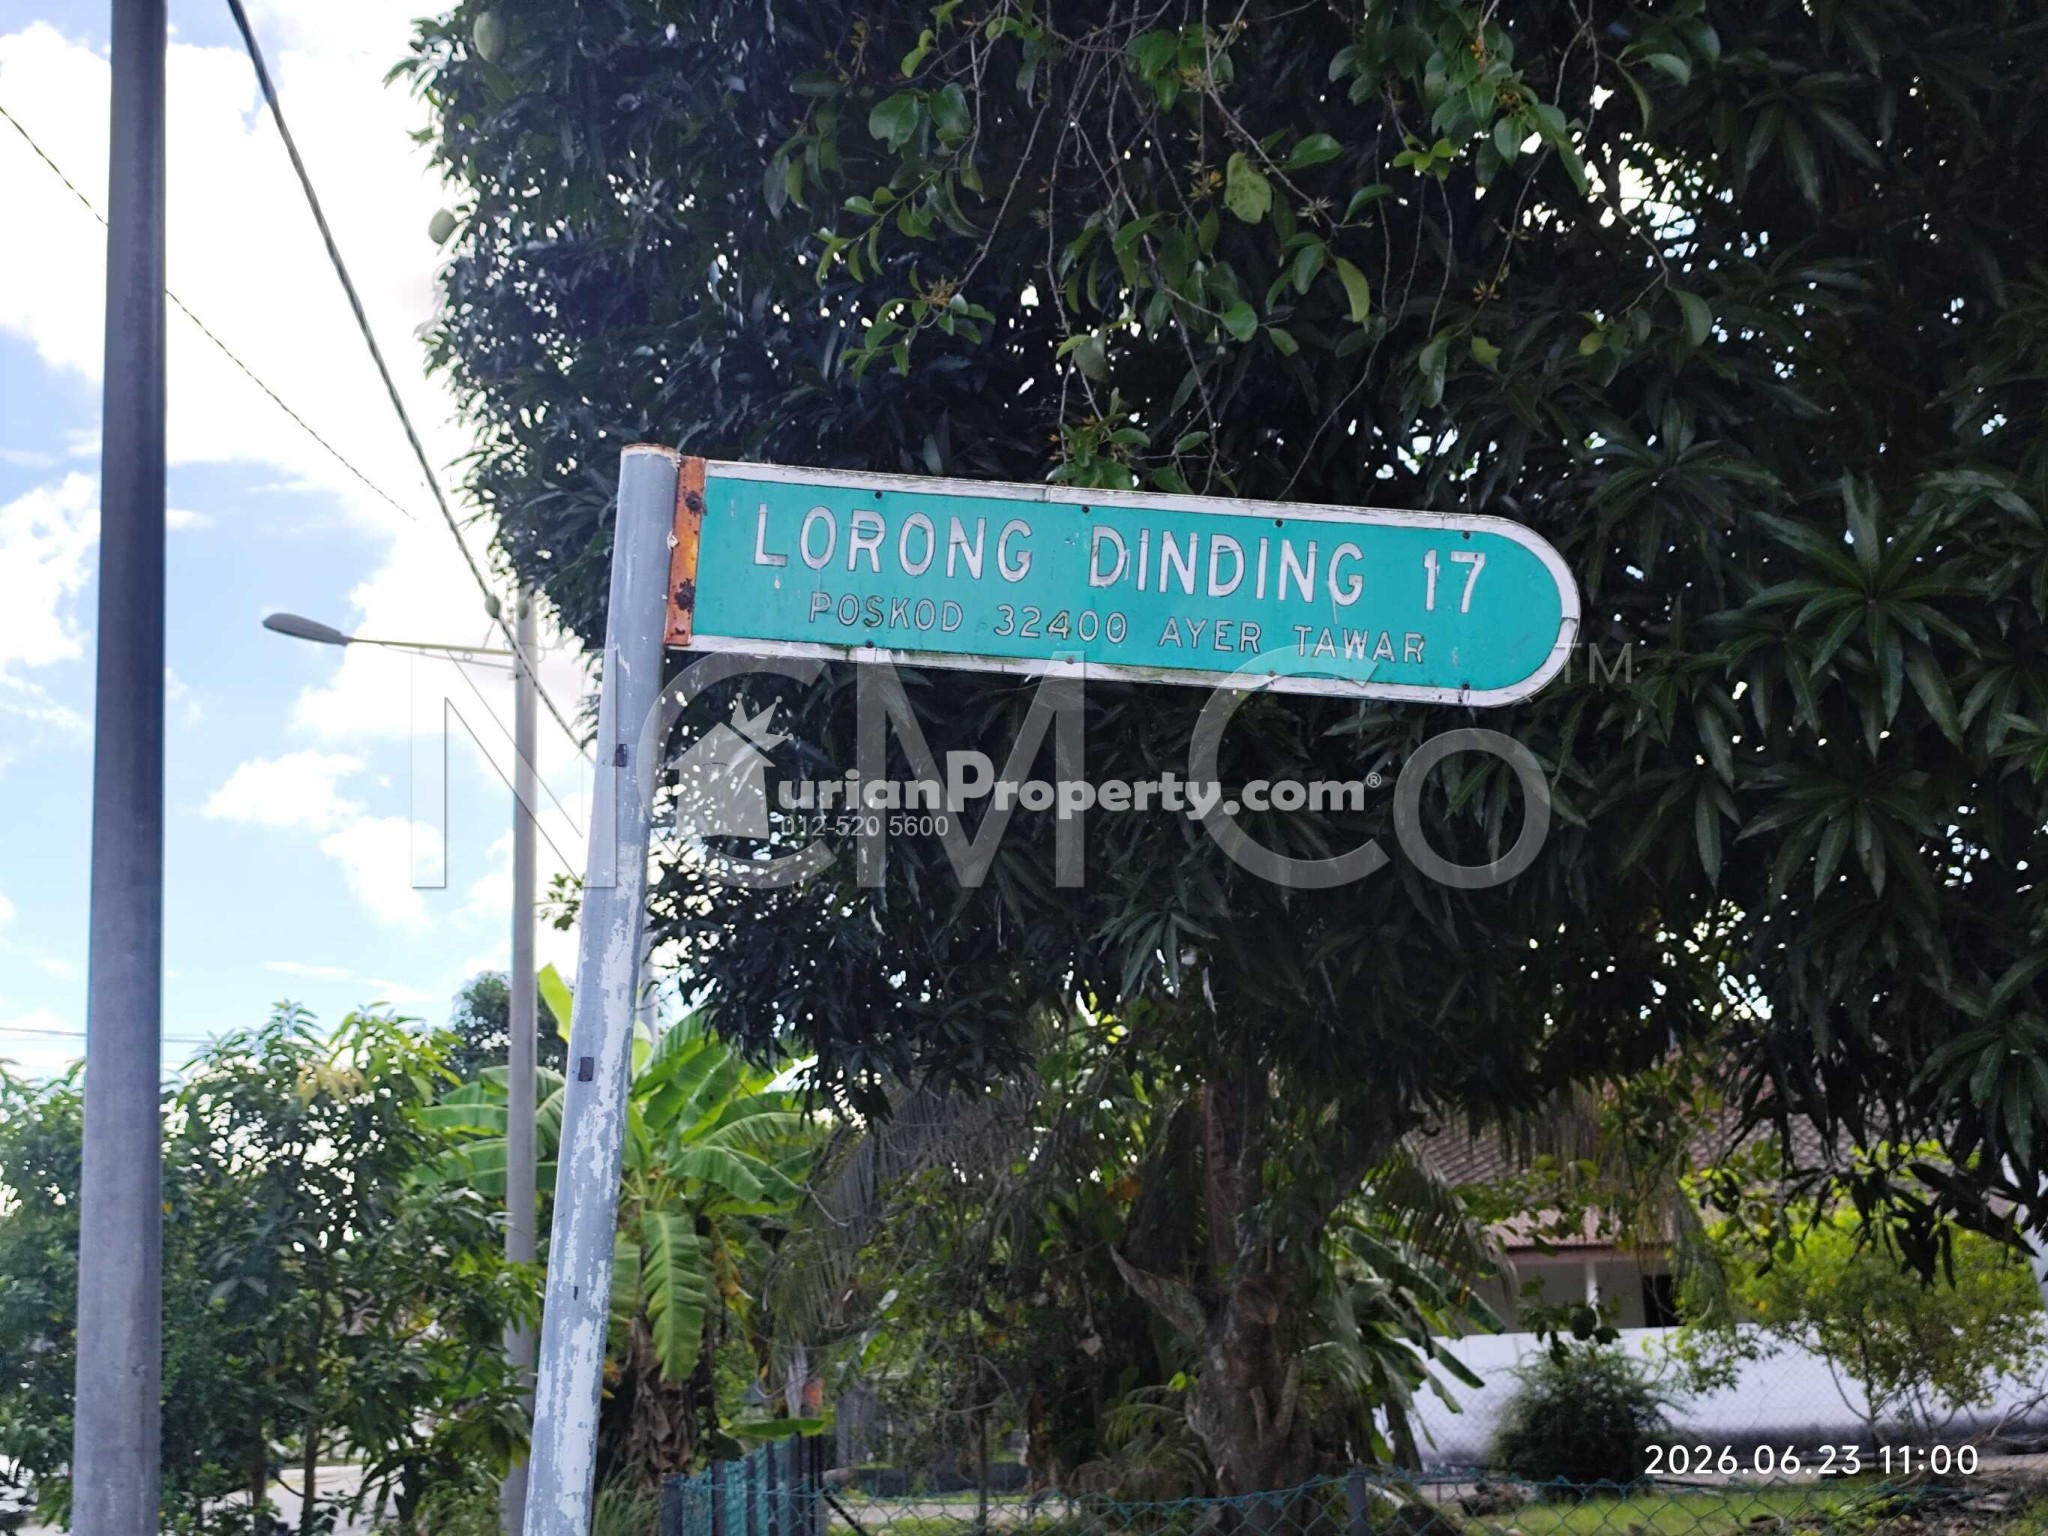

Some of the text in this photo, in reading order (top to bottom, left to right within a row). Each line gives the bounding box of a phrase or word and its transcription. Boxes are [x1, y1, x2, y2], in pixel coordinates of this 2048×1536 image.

[753, 503, 1485, 614] LORONG DINDING 17
[809, 592, 1425, 664] POSKOD 32400 AYER TAWAR
